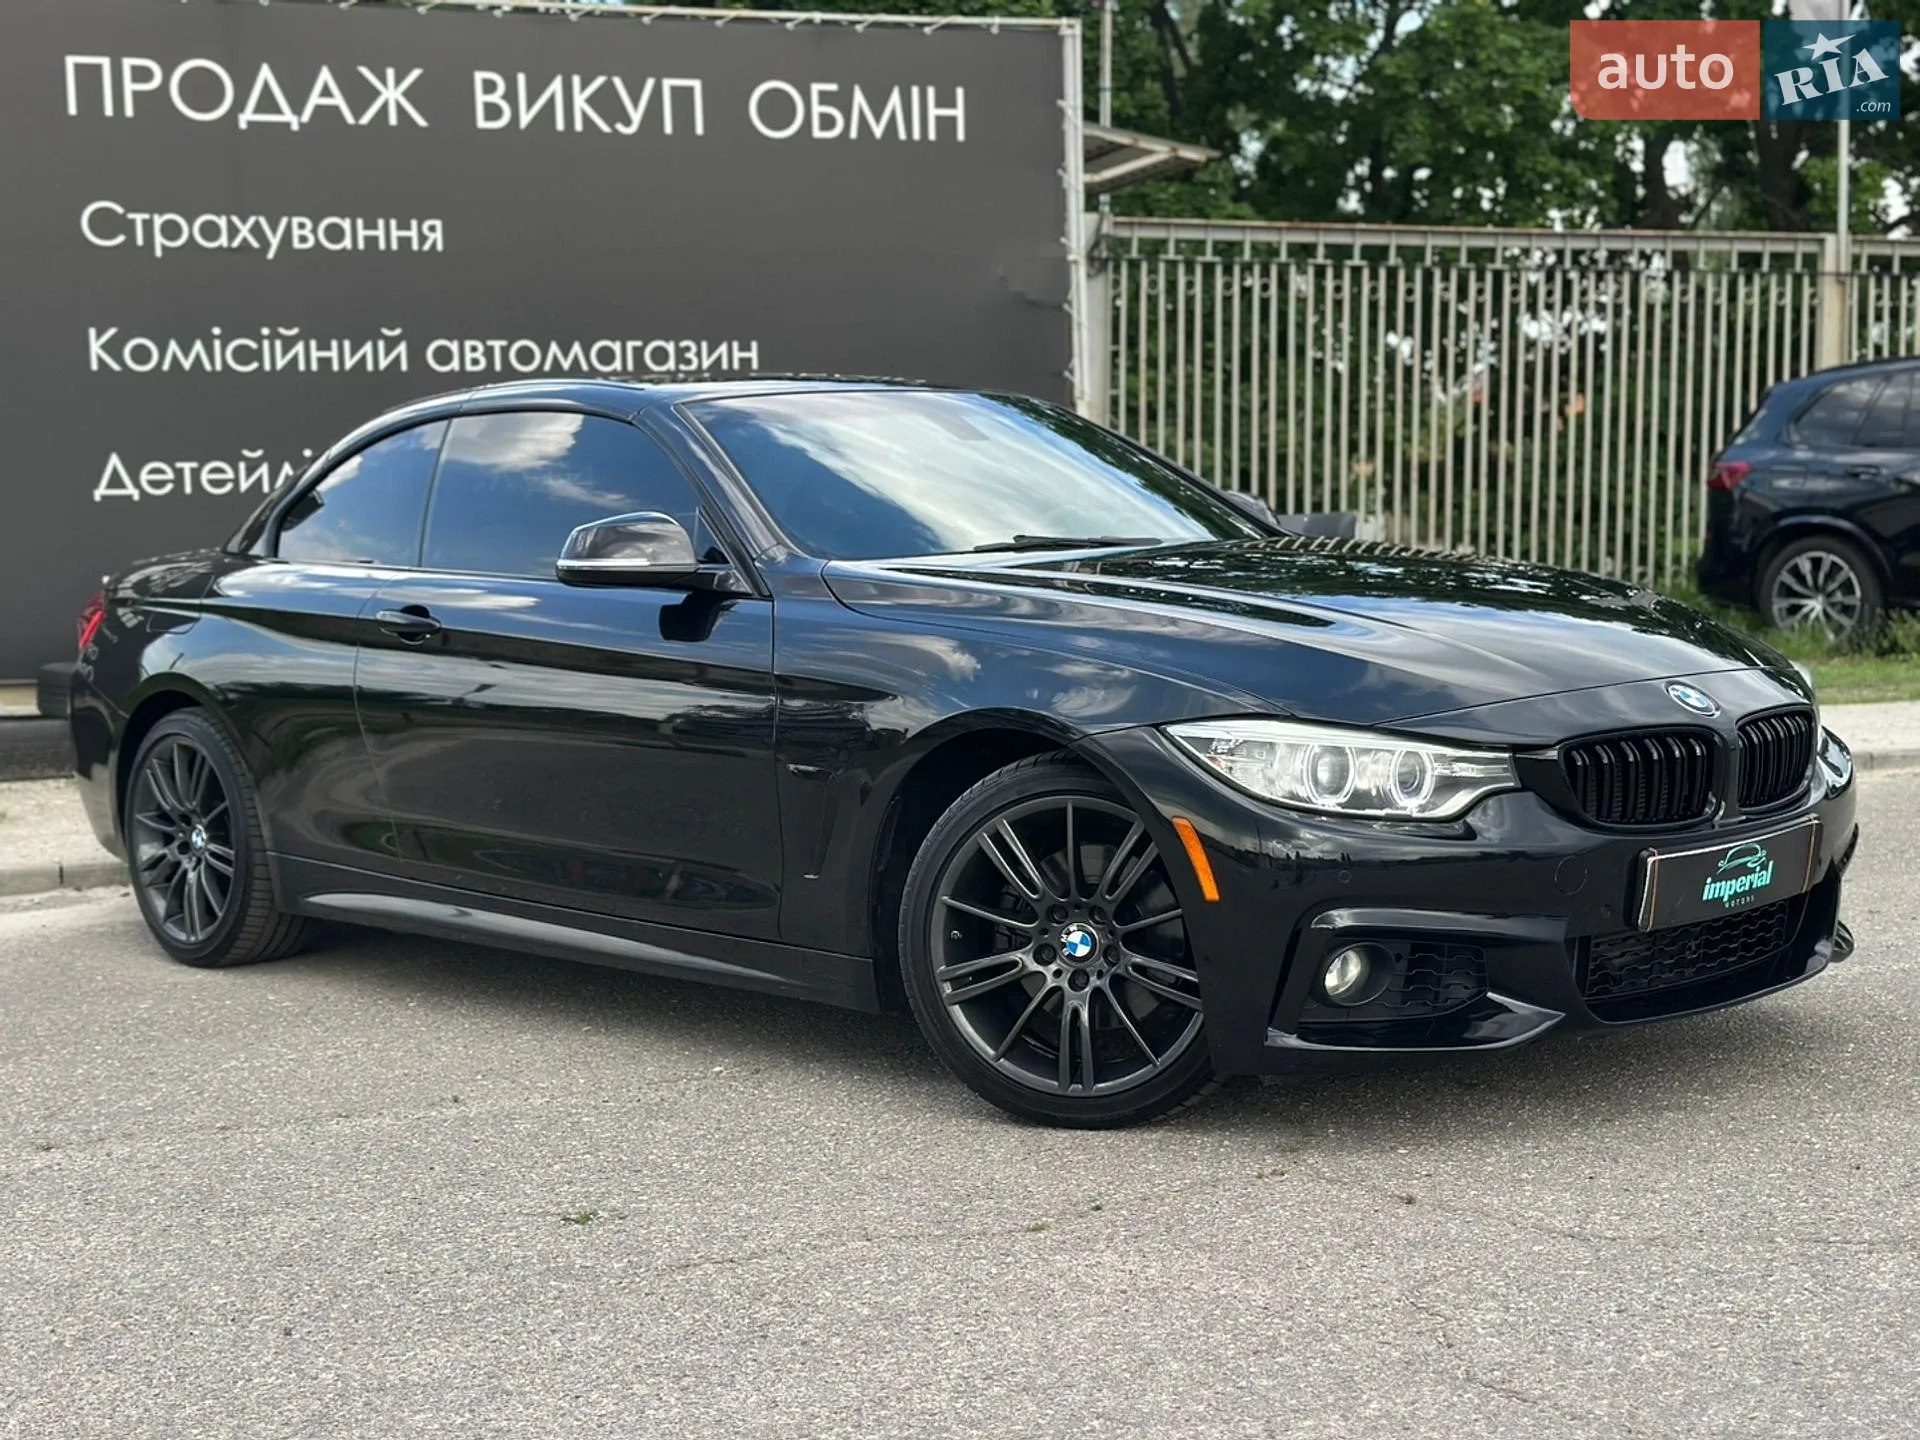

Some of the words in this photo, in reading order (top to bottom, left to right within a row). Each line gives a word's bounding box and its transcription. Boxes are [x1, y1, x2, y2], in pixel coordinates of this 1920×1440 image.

[64, 54, 429, 132] ПРОДАЖ
[473, 70, 705, 136] ВИКУП
[748, 79, 966, 142] ОБМІН
[80, 200, 444, 260] Страхування
[87, 326, 408, 373] Комісійний
[425, 337, 759, 373] автомагазин
[1702, 860, 1774, 902] imperial
